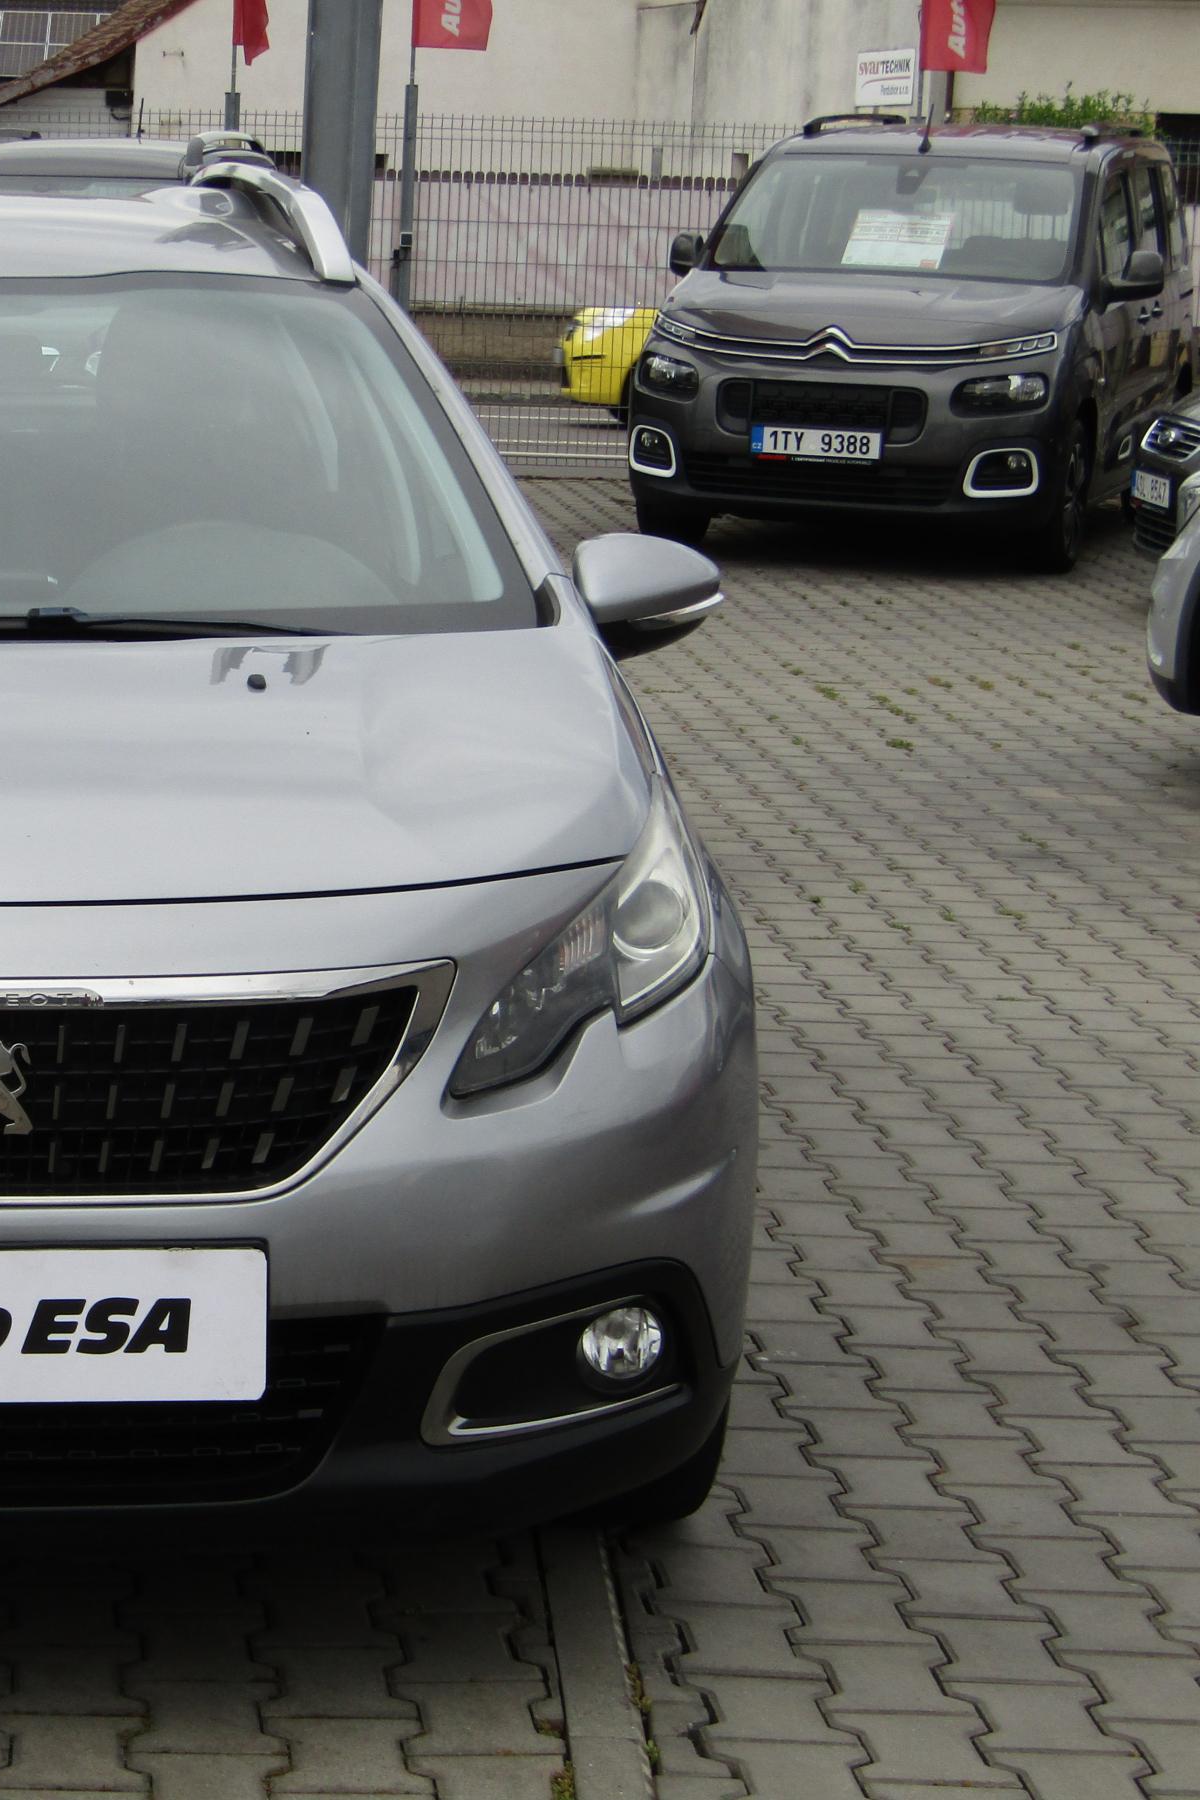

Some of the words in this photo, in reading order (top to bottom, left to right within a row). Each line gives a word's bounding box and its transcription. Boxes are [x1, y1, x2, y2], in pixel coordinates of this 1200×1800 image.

[769, 430, 804, 452] 1TY
[820, 433, 871, 455] 9388
[21, 1297, 192, 1355] ESA
